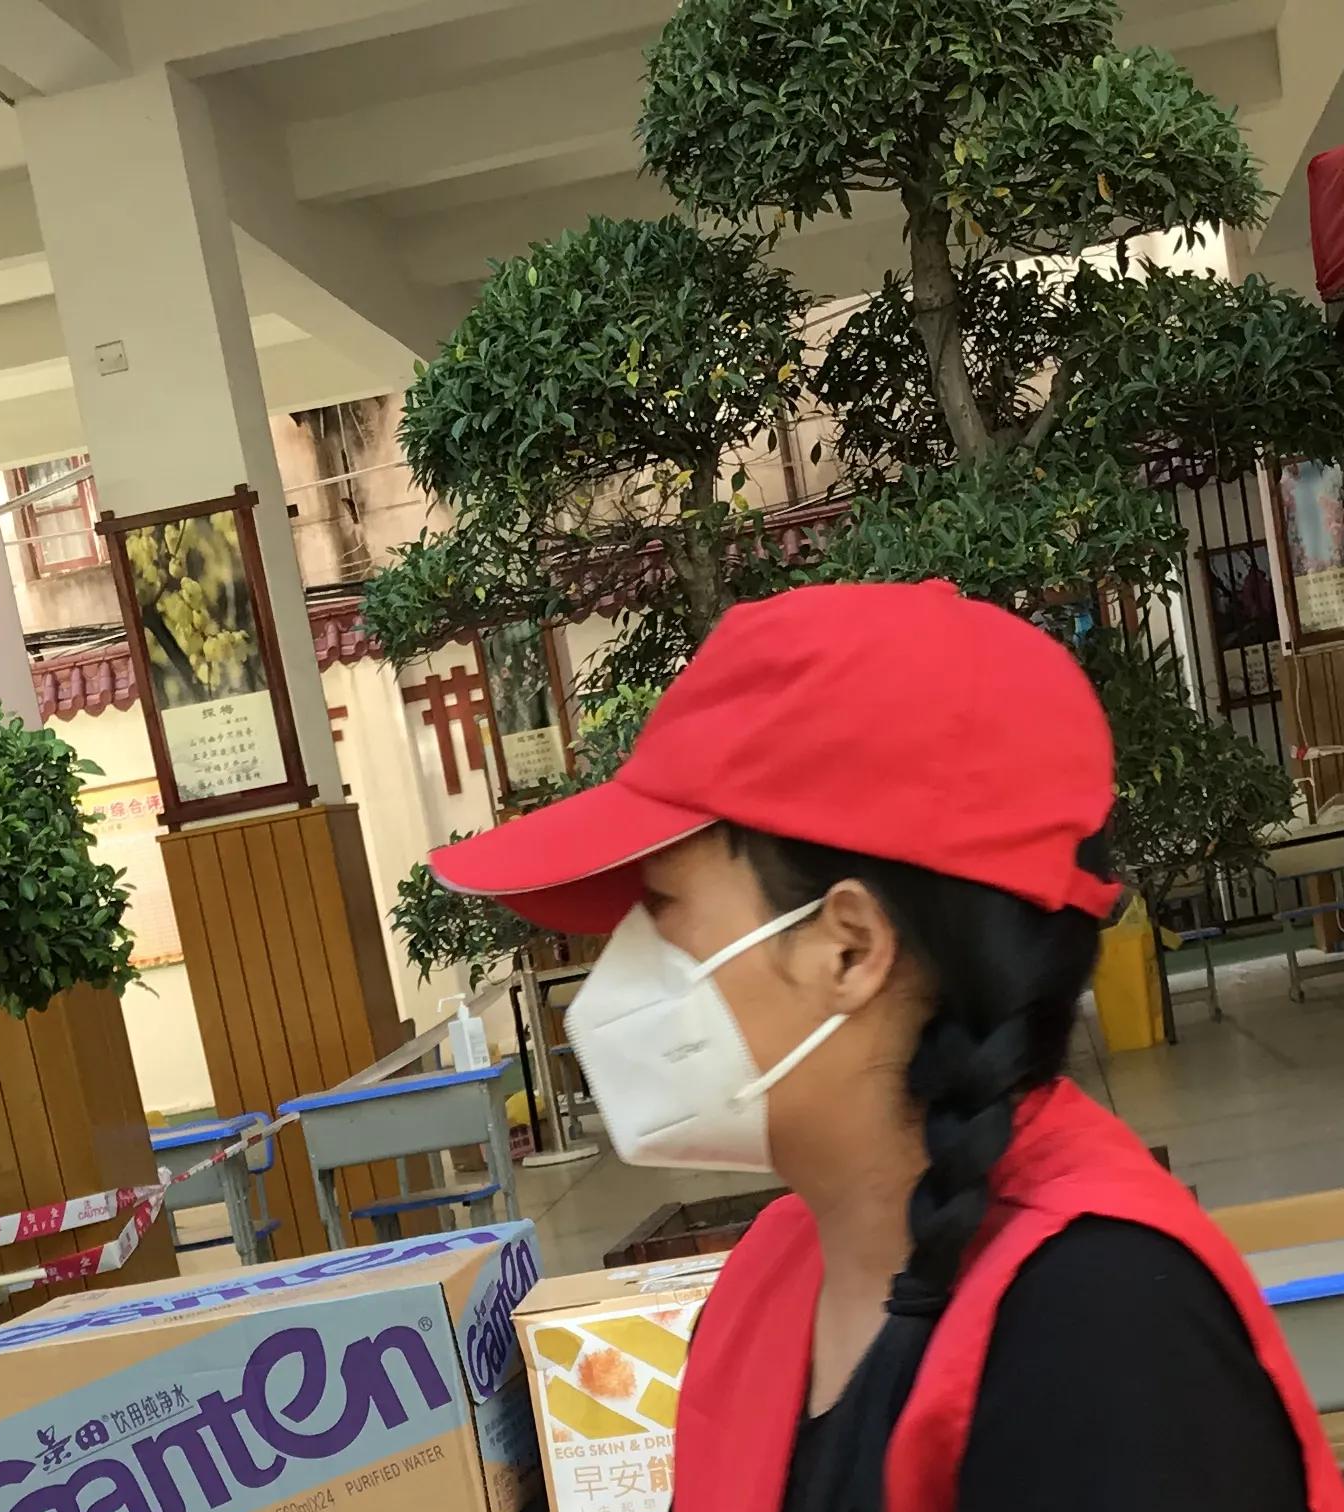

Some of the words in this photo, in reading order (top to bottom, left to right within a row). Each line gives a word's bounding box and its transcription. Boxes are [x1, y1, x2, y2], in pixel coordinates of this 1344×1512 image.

[23, 1219, 57, 1236] SAFE
[110, 1383, 190, 1435] 饮用纯净水
[554, 1446, 585, 1459] EGG
[589, 1441, 625, 1457] SKIN
[630, 1440, 640, 1451] &
[345, 1463, 401, 1496] PURIFIED
[403, 1445, 445, 1472] WATER
